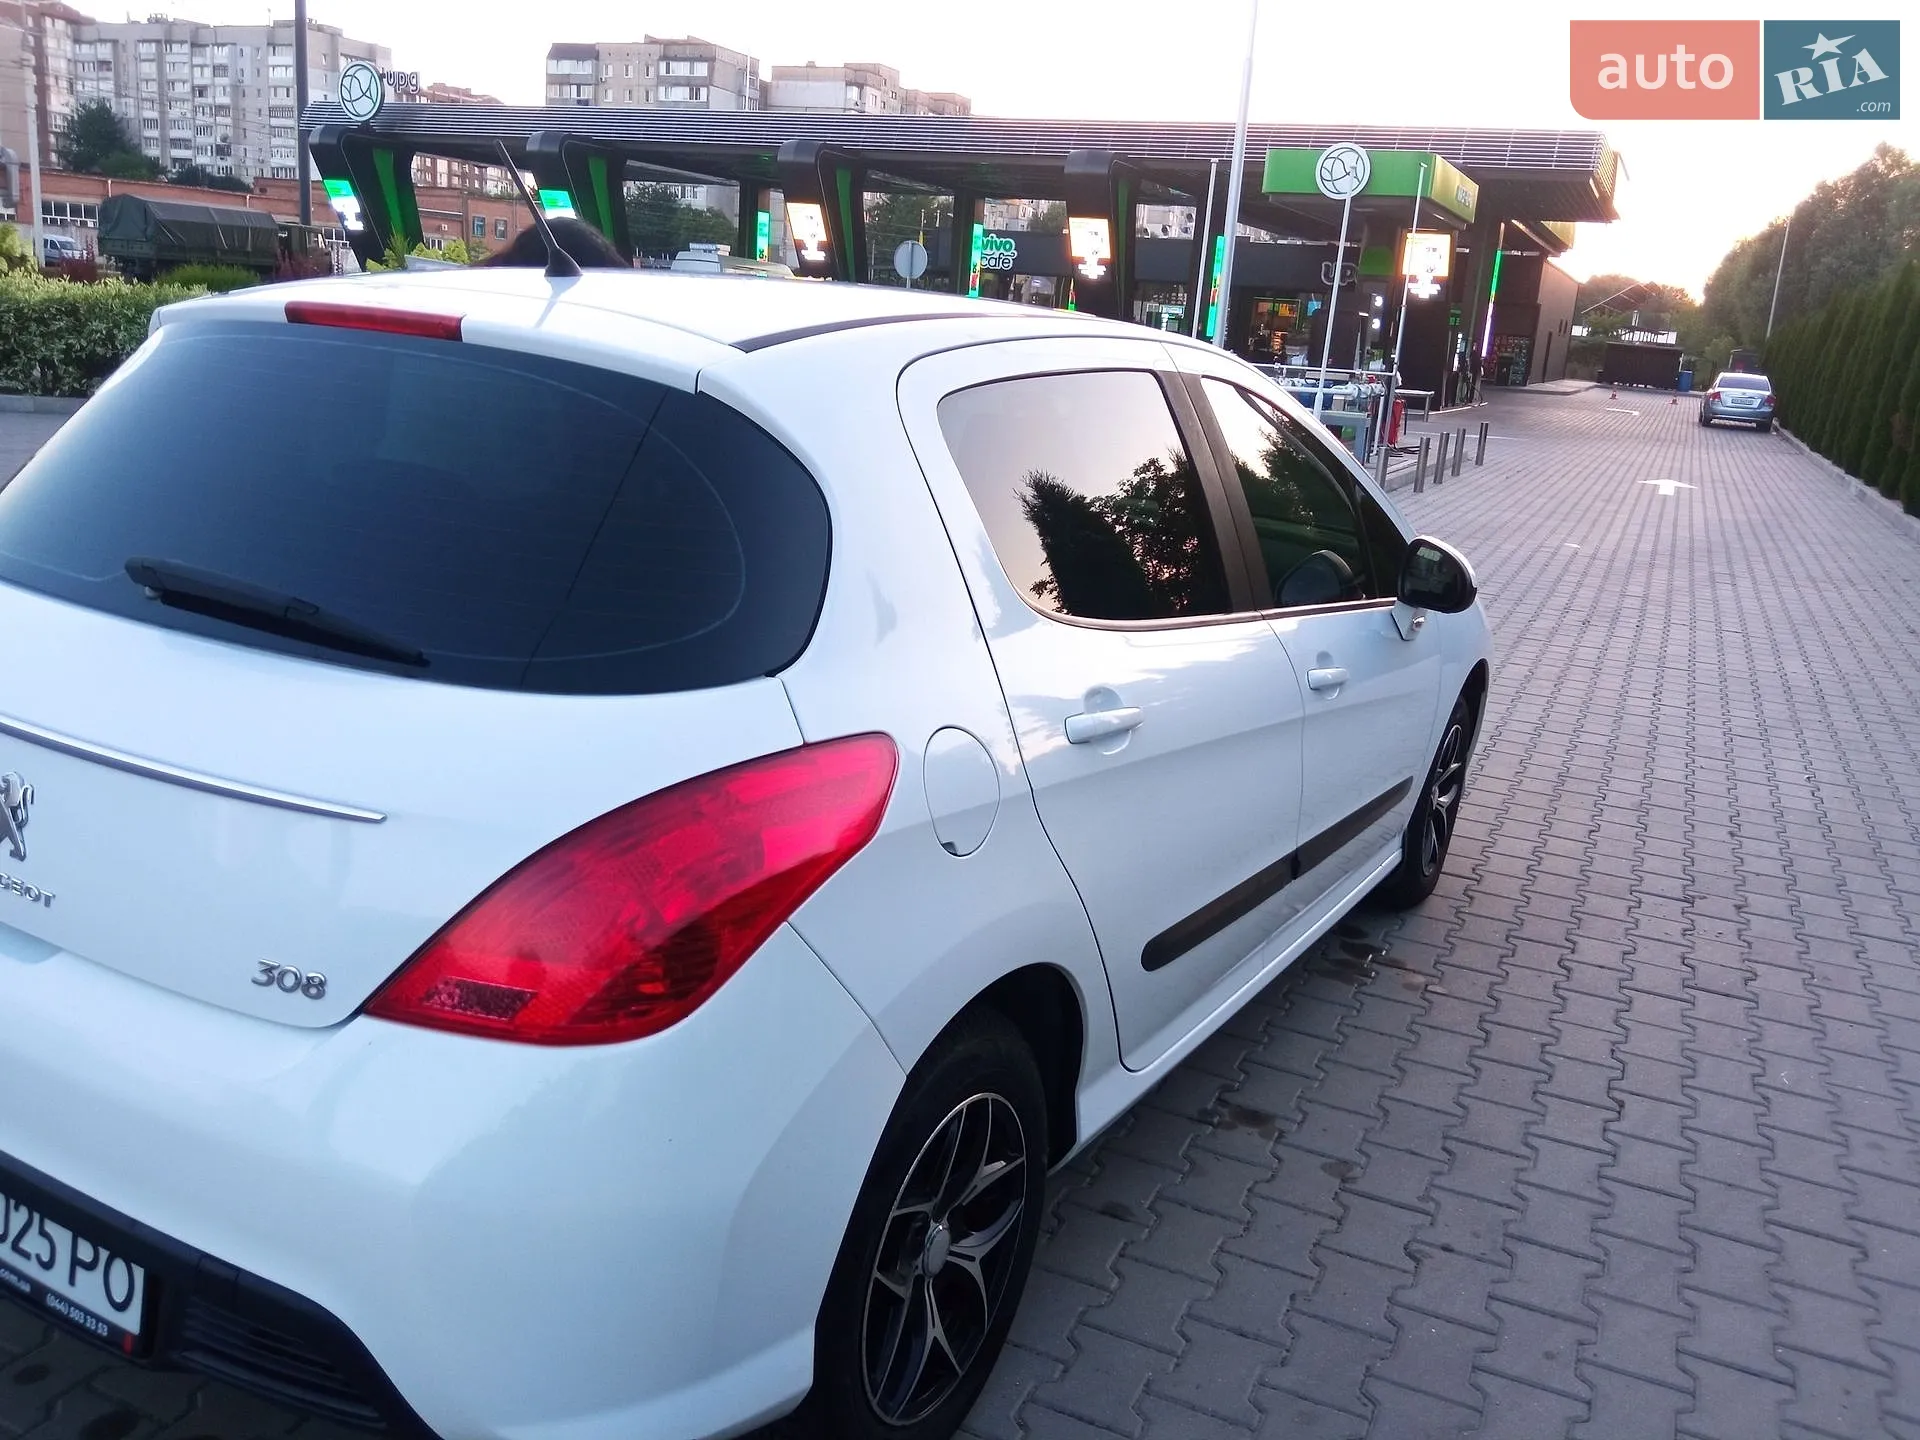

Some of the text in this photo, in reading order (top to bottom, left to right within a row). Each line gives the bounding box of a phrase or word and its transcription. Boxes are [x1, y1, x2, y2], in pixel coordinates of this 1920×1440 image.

[386, 71, 420, 94] upg
[981, 233, 1015, 252] vivo
[1321, 261, 1359, 286] UP
[251, 958, 327, 1000] 308
[69, 1232, 135, 1312] PO
[69, 1306, 85, 1324] 503
